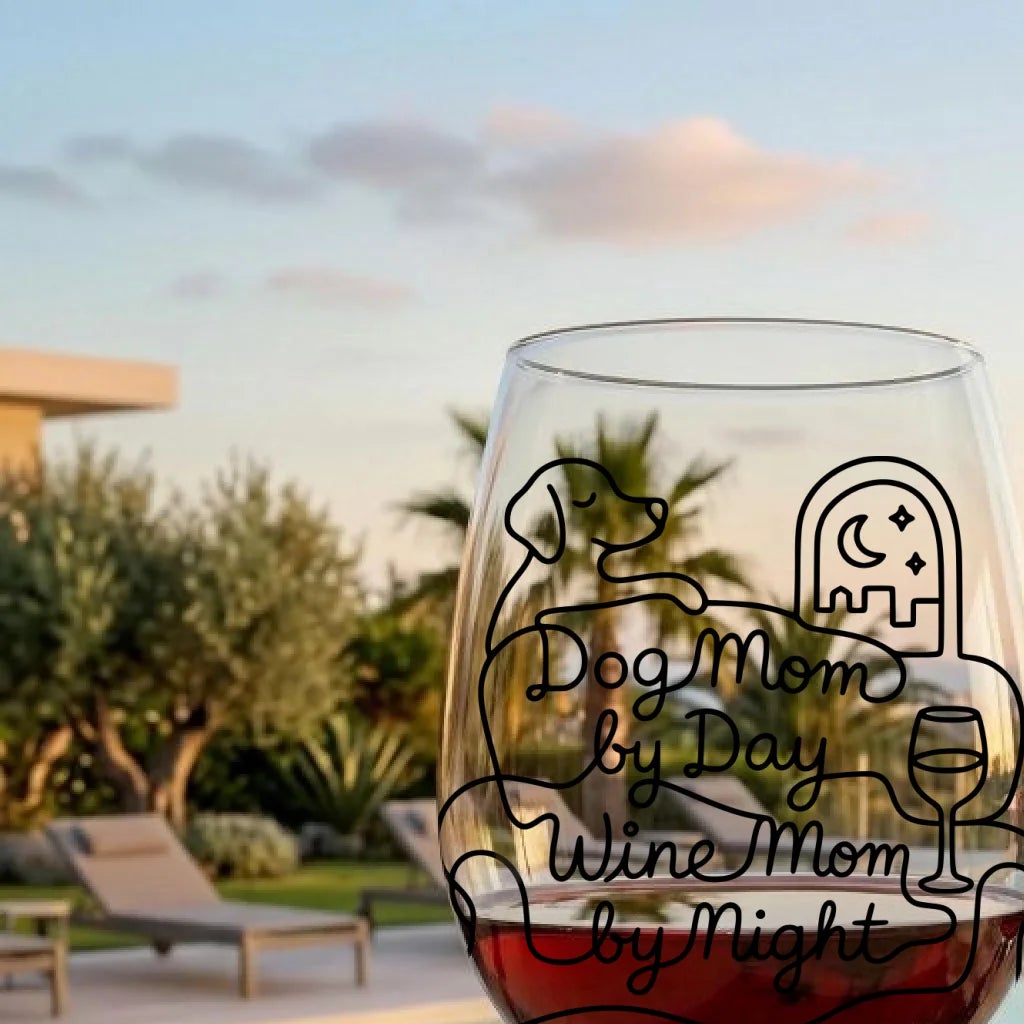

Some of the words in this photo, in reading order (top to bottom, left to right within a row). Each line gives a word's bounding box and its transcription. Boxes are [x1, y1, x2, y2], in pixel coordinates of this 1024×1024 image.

[526, 623, 668, 721] Dog
[697, 628, 872, 703] Mom
[594, 709, 662, 808] by
[683, 708, 828, 811] Day
[547, 812, 722, 882] Wine
[752, 815, 910, 879] Mom
[592, 900, 664, 995] by
[694, 900, 889, 993] Night
